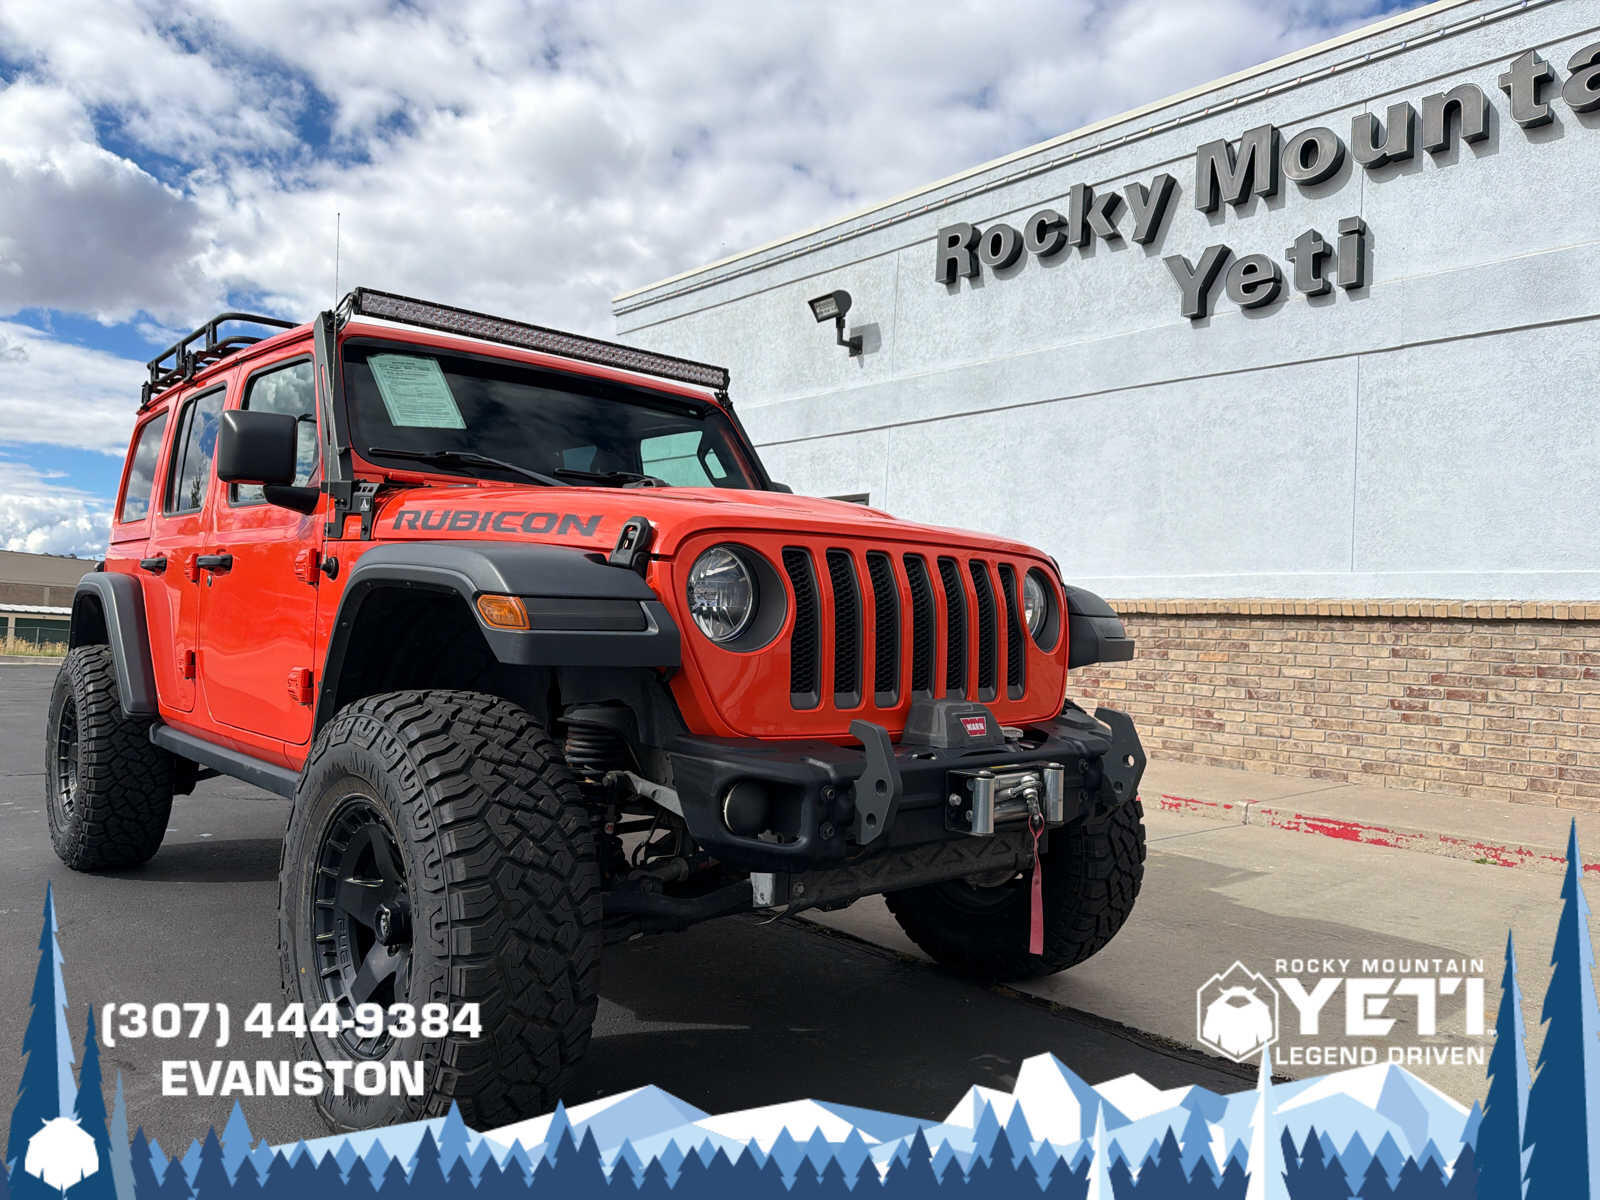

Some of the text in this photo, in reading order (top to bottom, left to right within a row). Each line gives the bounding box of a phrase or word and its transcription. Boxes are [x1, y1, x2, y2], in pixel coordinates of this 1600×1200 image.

[936, 173, 1176, 284] Rocky
[1163, 216, 1366, 318] Yeti
[392, 510, 604, 537] RUBICON
